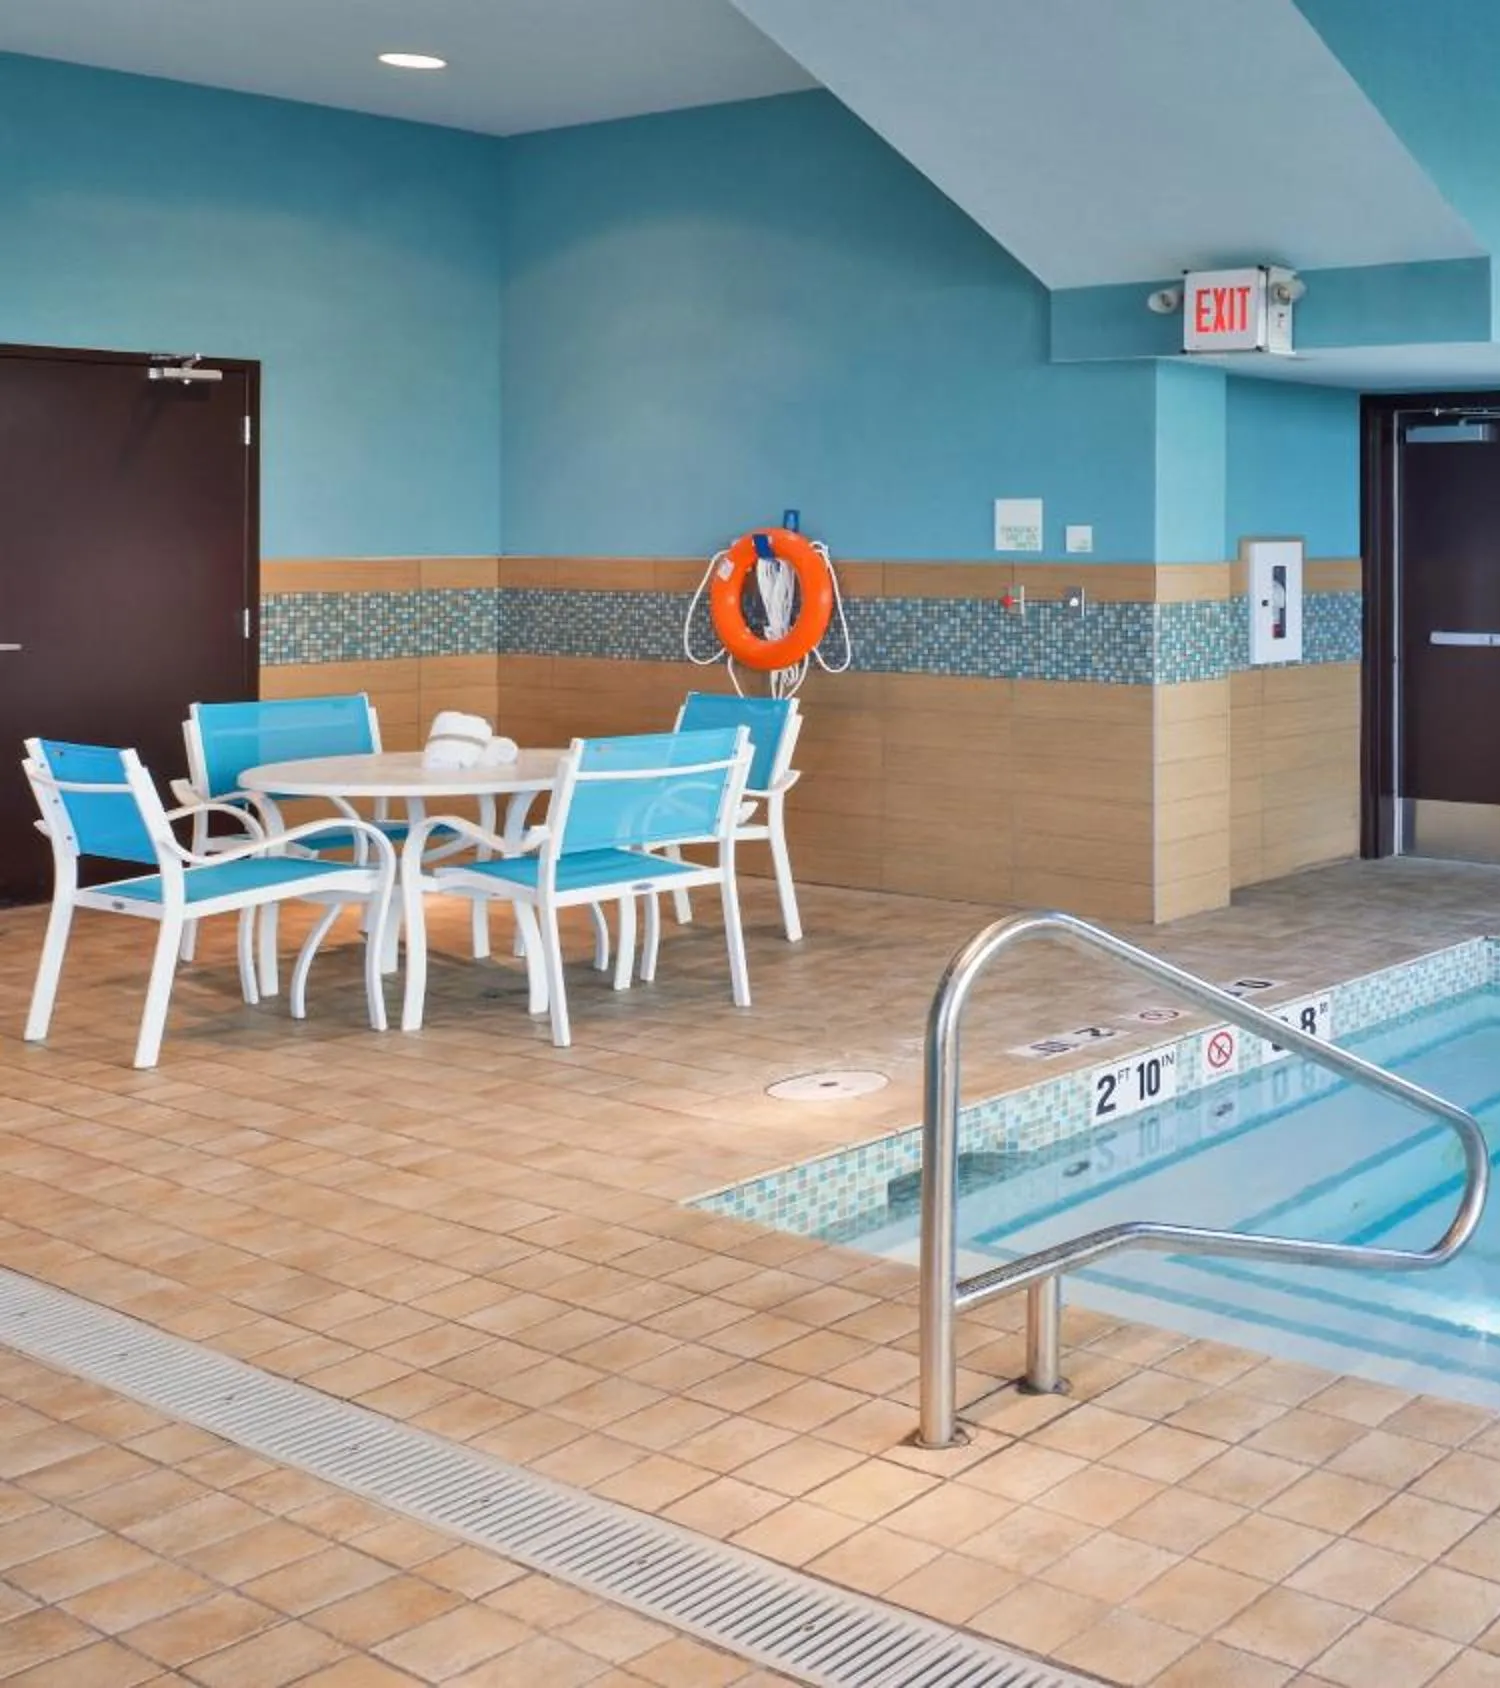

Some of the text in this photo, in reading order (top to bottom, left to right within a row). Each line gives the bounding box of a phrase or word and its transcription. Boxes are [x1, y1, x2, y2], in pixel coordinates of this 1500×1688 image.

[1196, 286, 1251, 333] EXIT
[1096, 1052, 1175, 1116] 2 FT 10 IN
